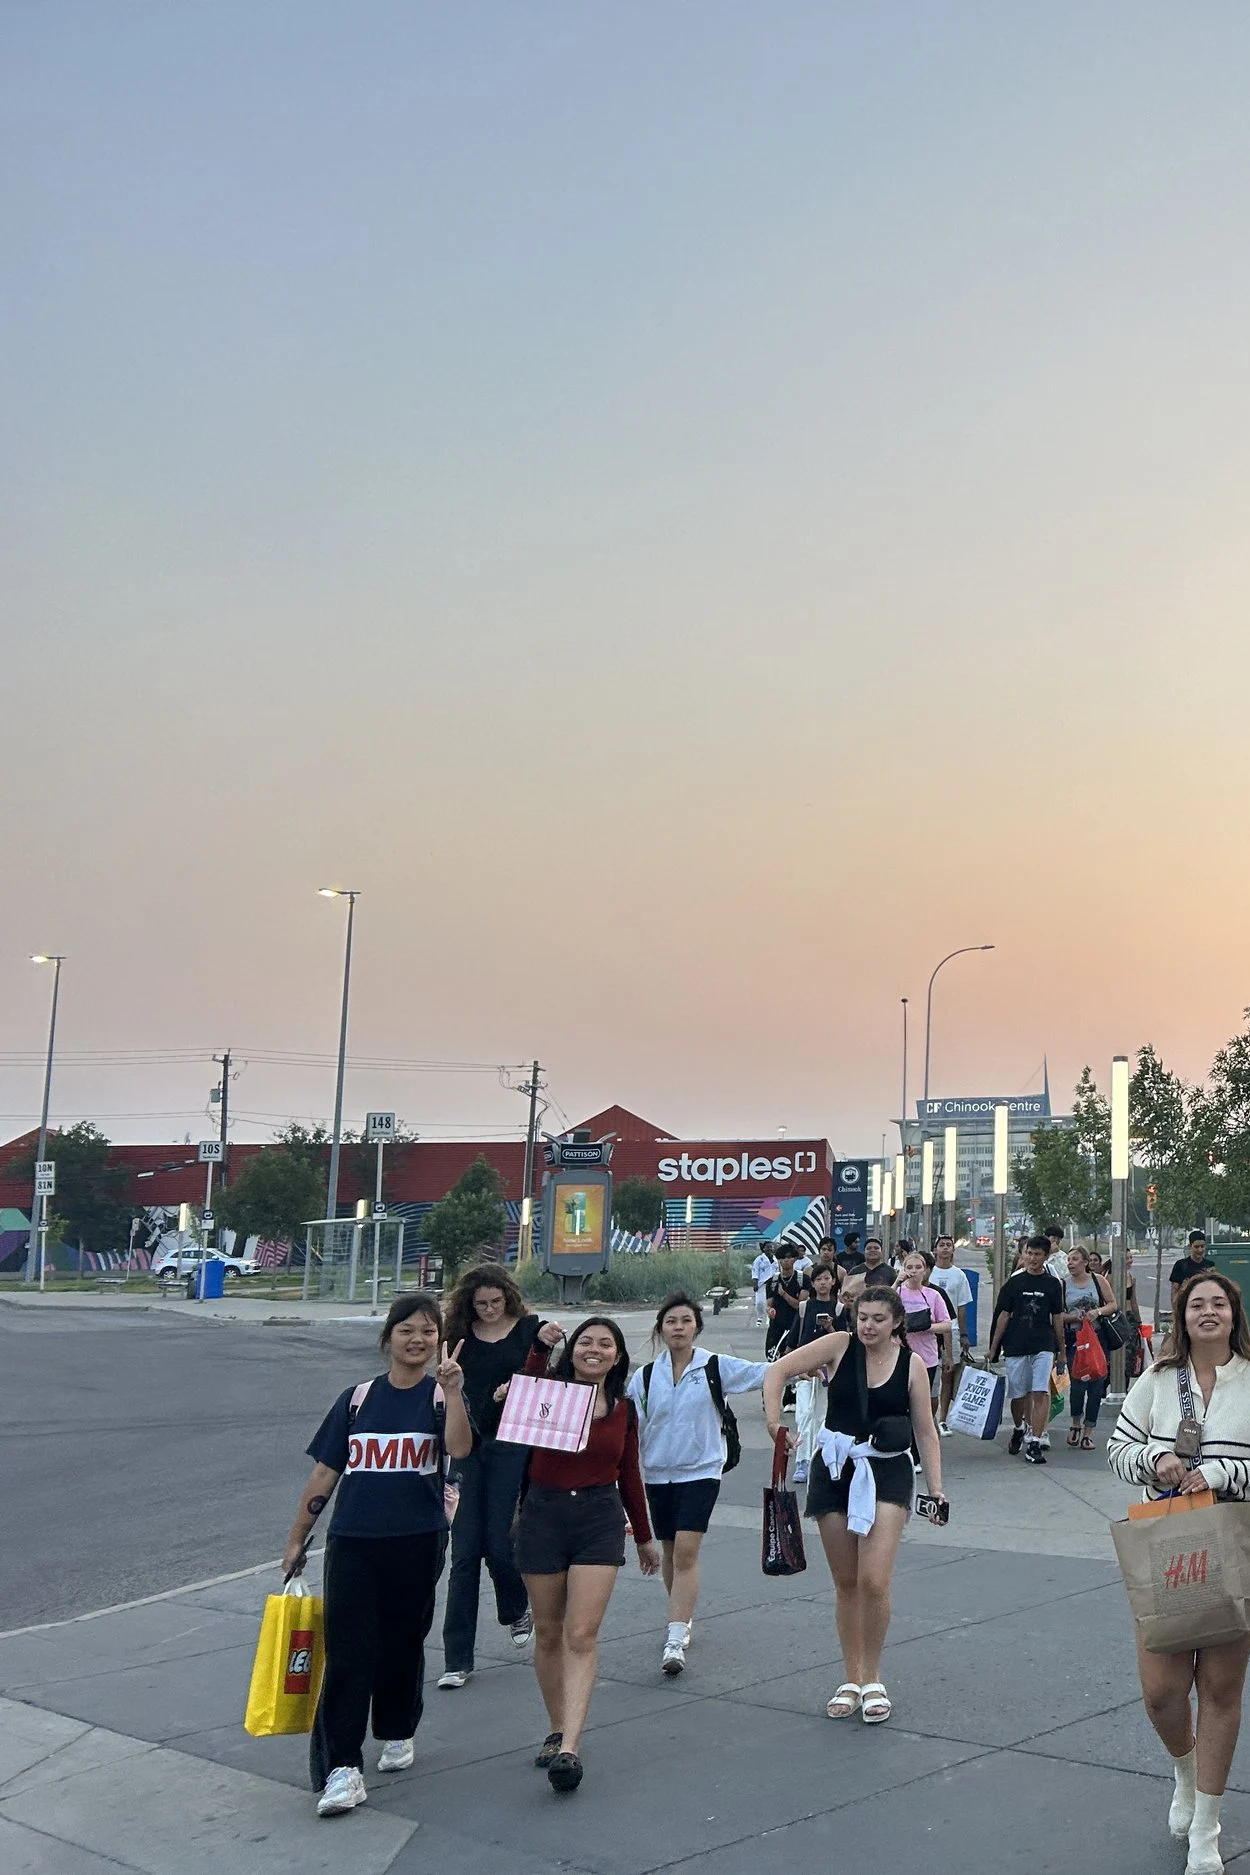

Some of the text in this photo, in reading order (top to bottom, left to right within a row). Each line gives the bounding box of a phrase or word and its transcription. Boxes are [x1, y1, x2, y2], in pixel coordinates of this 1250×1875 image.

[926, 1101, 1041, 1113] CF Chinook entre
[372, 1116, 391, 1129] 148
[202, 1144, 220, 1154] 10S
[38, 1164, 52, 1172] 10N
[658, 1152, 792, 1186] staples
[965, 1382, 990, 1396] KNOW
[348, 1438, 438, 1469] OMM
